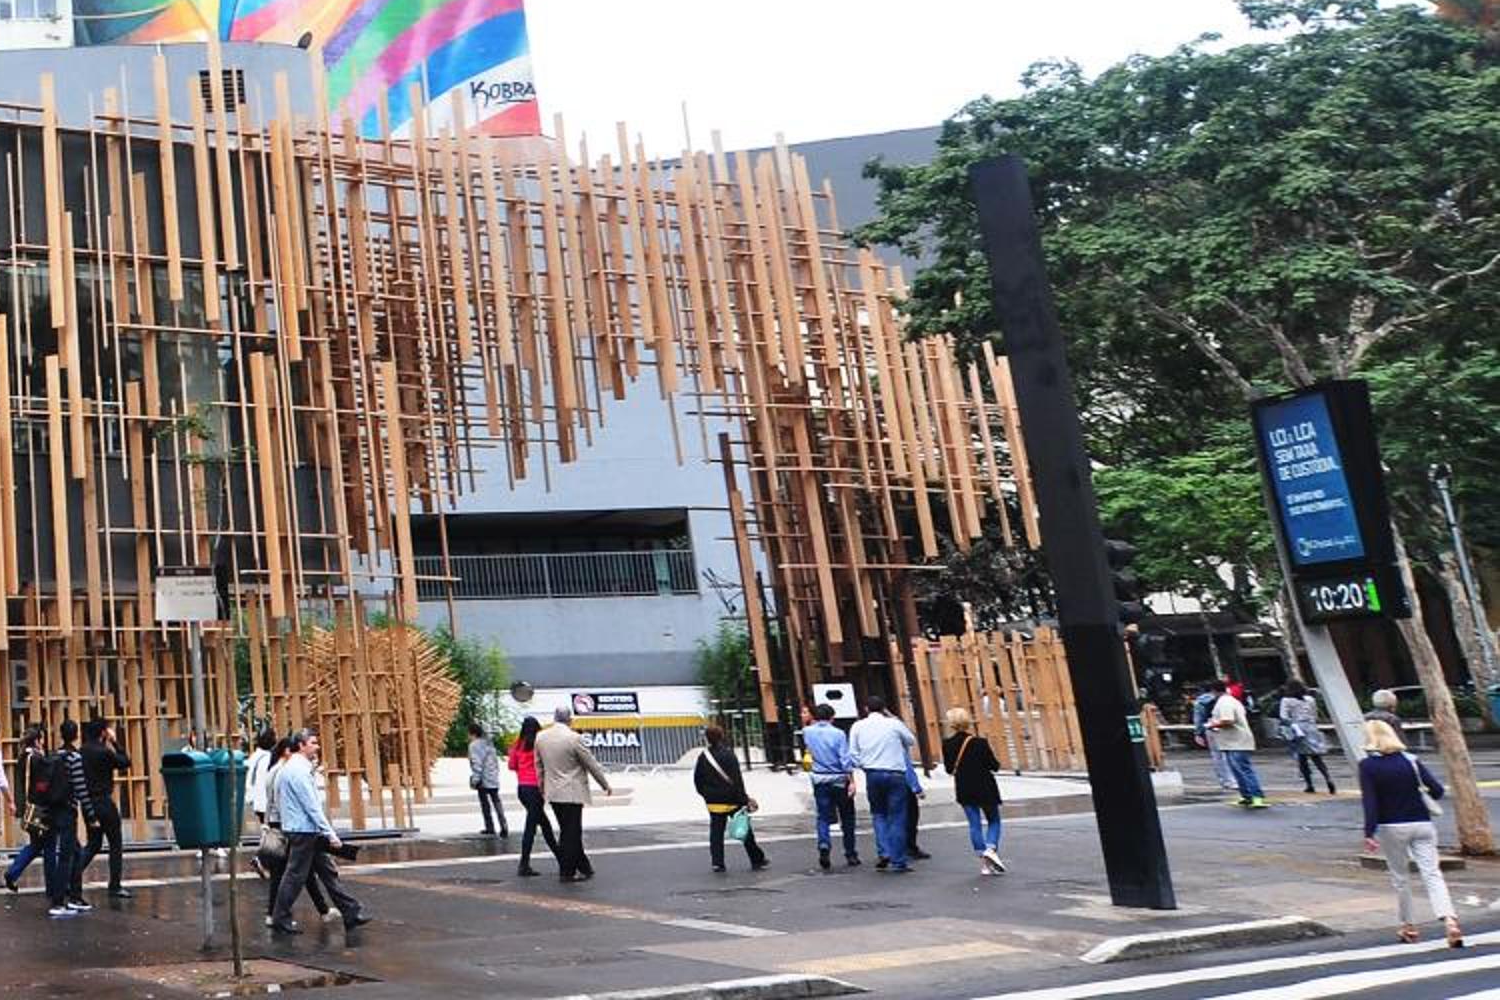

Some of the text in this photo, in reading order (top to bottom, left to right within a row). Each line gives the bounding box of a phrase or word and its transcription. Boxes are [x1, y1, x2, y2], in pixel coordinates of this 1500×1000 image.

[470, 81, 536, 106] KOBRA
[1310, 583, 1363, 611] 10:20
[581, 730, 641, 747] SAÍDA
